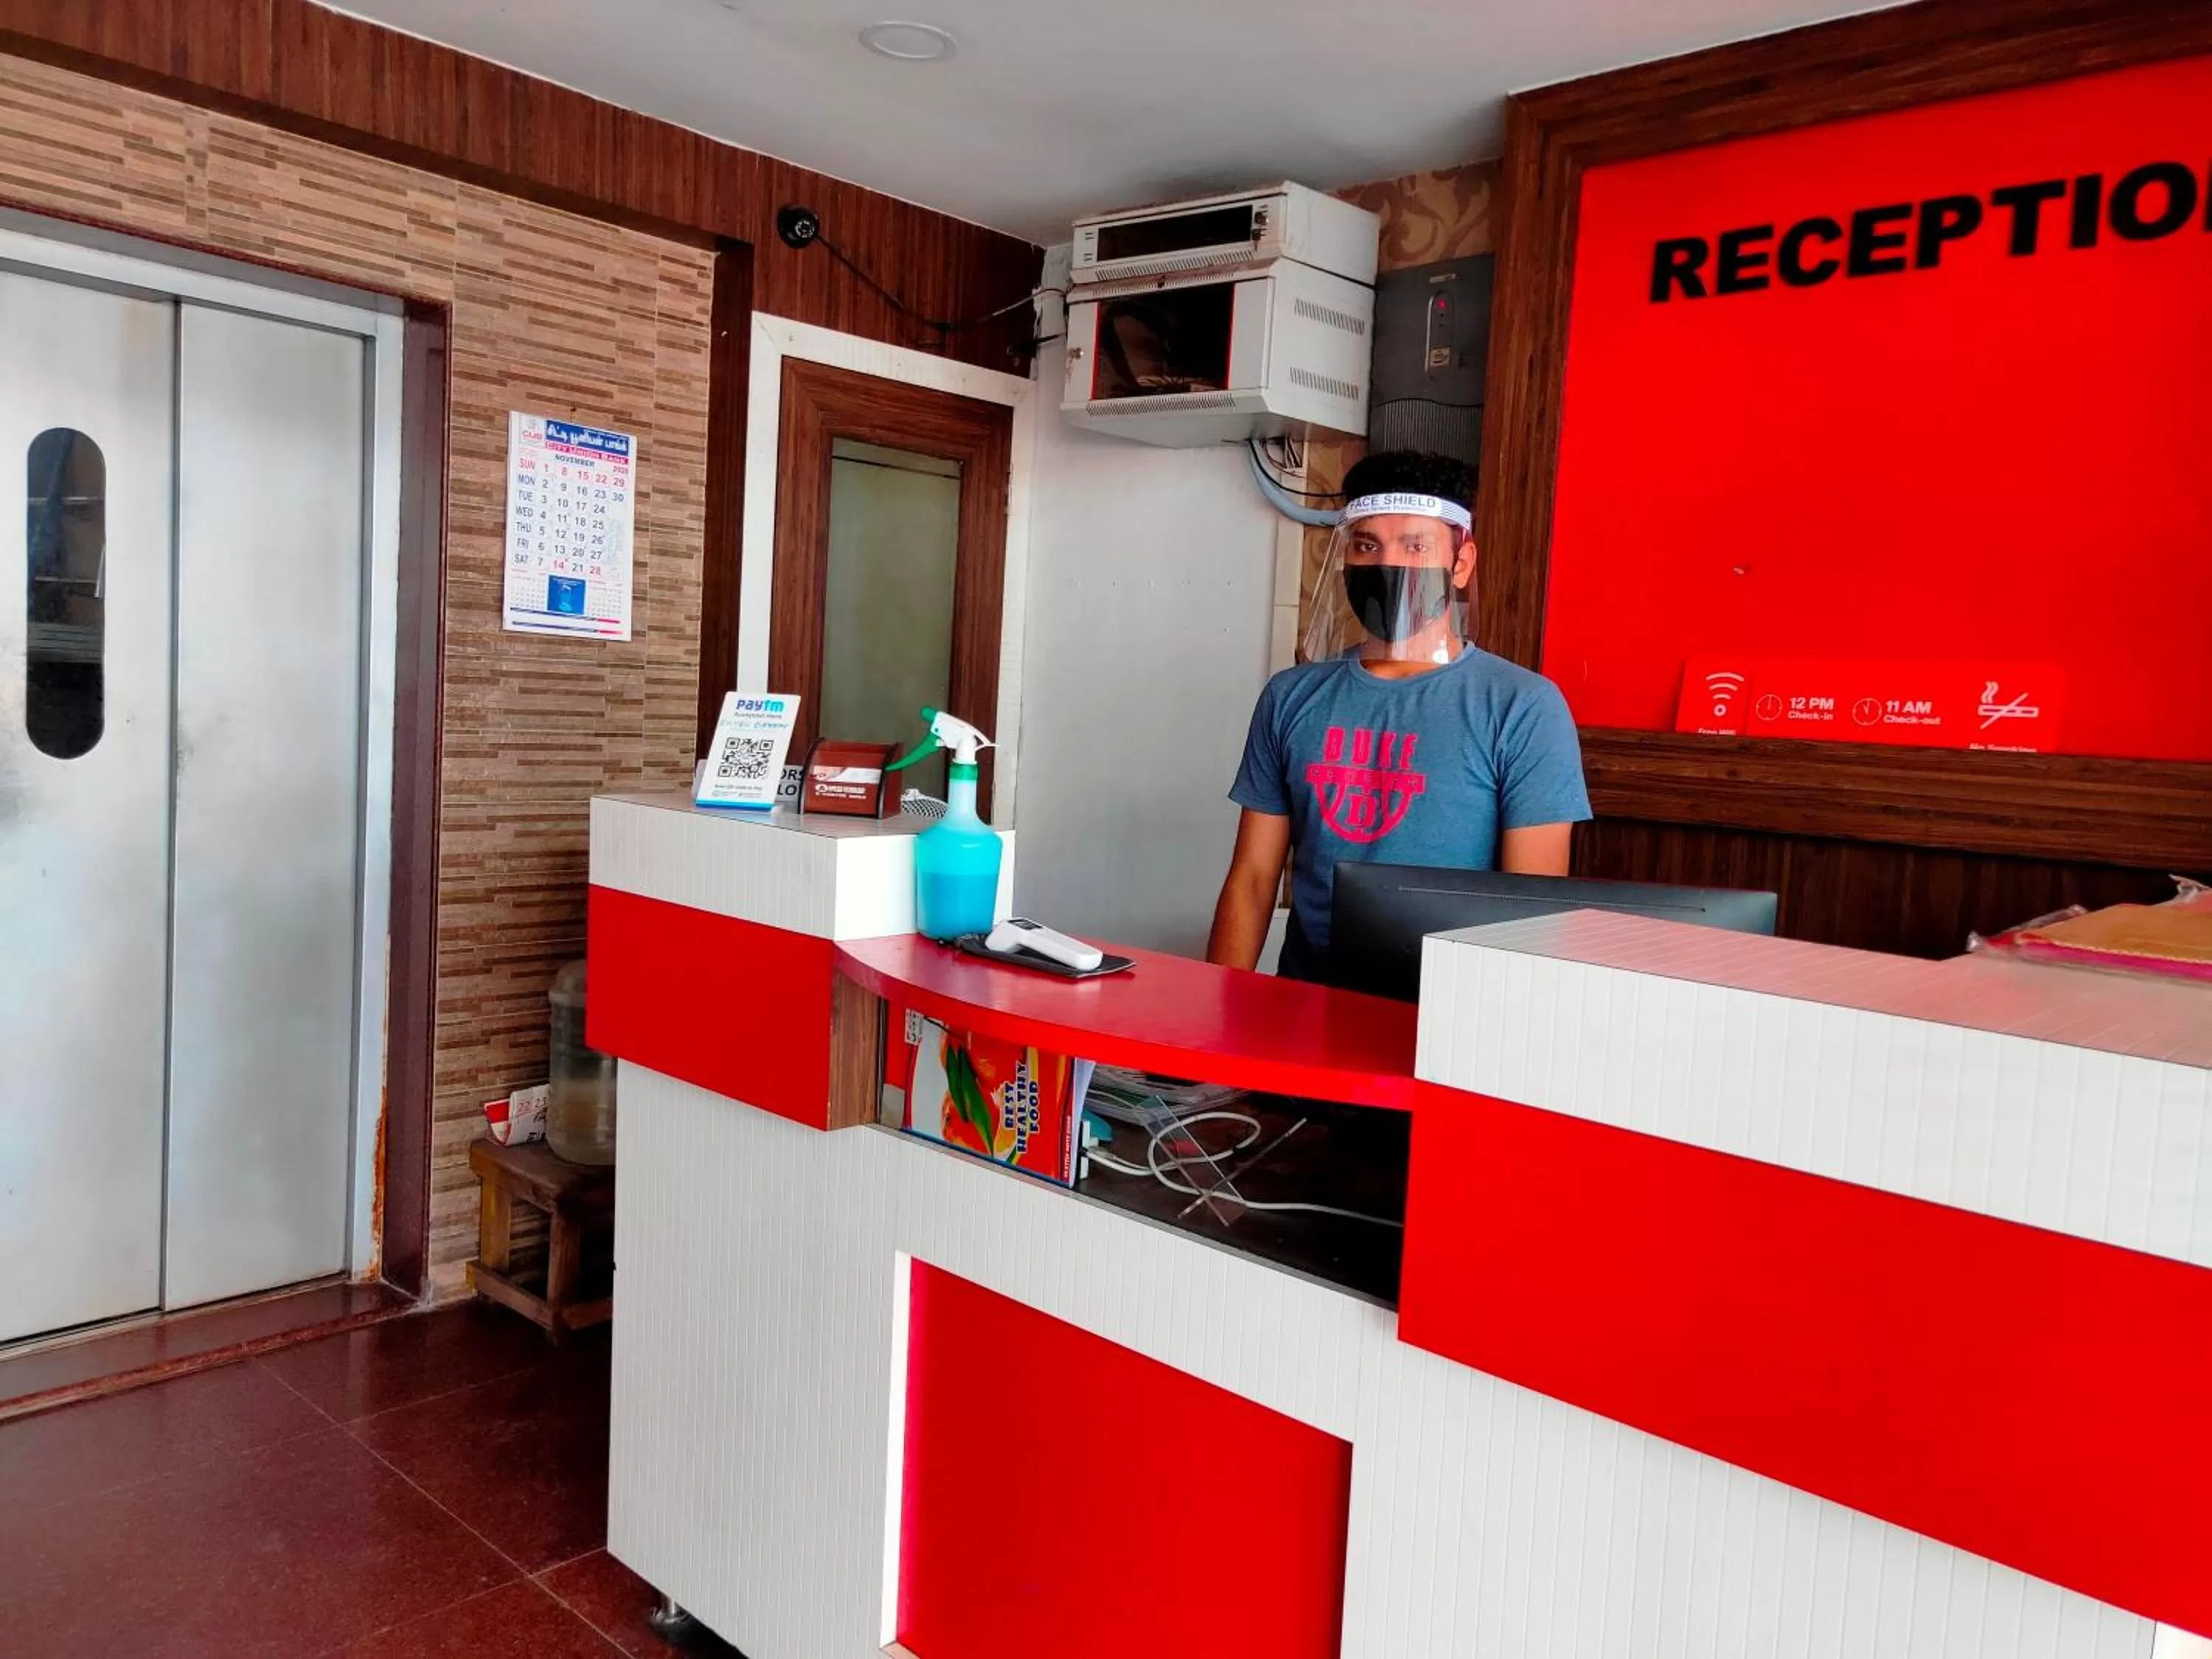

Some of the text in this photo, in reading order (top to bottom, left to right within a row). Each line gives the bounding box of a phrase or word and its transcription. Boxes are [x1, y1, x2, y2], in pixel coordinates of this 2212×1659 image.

[1649, 158, 2212, 303] RECEPTIO
[519, 458, 625, 487] SUN 1 8 15 22 29
[554, 453, 595, 470] NOVEMBER
[518, 474, 625, 502] MON 2 9 16 23 30
[518, 490, 605, 514] TUE 3 10 17 24
[1351, 495, 1378, 511] FACE
[1383, 495, 1436, 508] SHIELD
[516, 506, 604, 529] WED 4 11 18 25
[517, 521, 604, 545] THU 5 12 19 26
[517, 538, 602, 560] FRI 6 13 20 27
[514, 554, 601, 575] SAT 7 14 21 28
[1787, 710, 1834, 720] Check-in
[1790, 696, 1834, 711] 12 PM
[1886, 700, 1933, 714] 11 AM
[1883, 714, 1941, 726] Check-out
[1004, 1081, 1015, 1129] BEST
[1016, 1060, 1028, 1153] HEALTHY
[1029, 1080, 1040, 1133] FOOD
